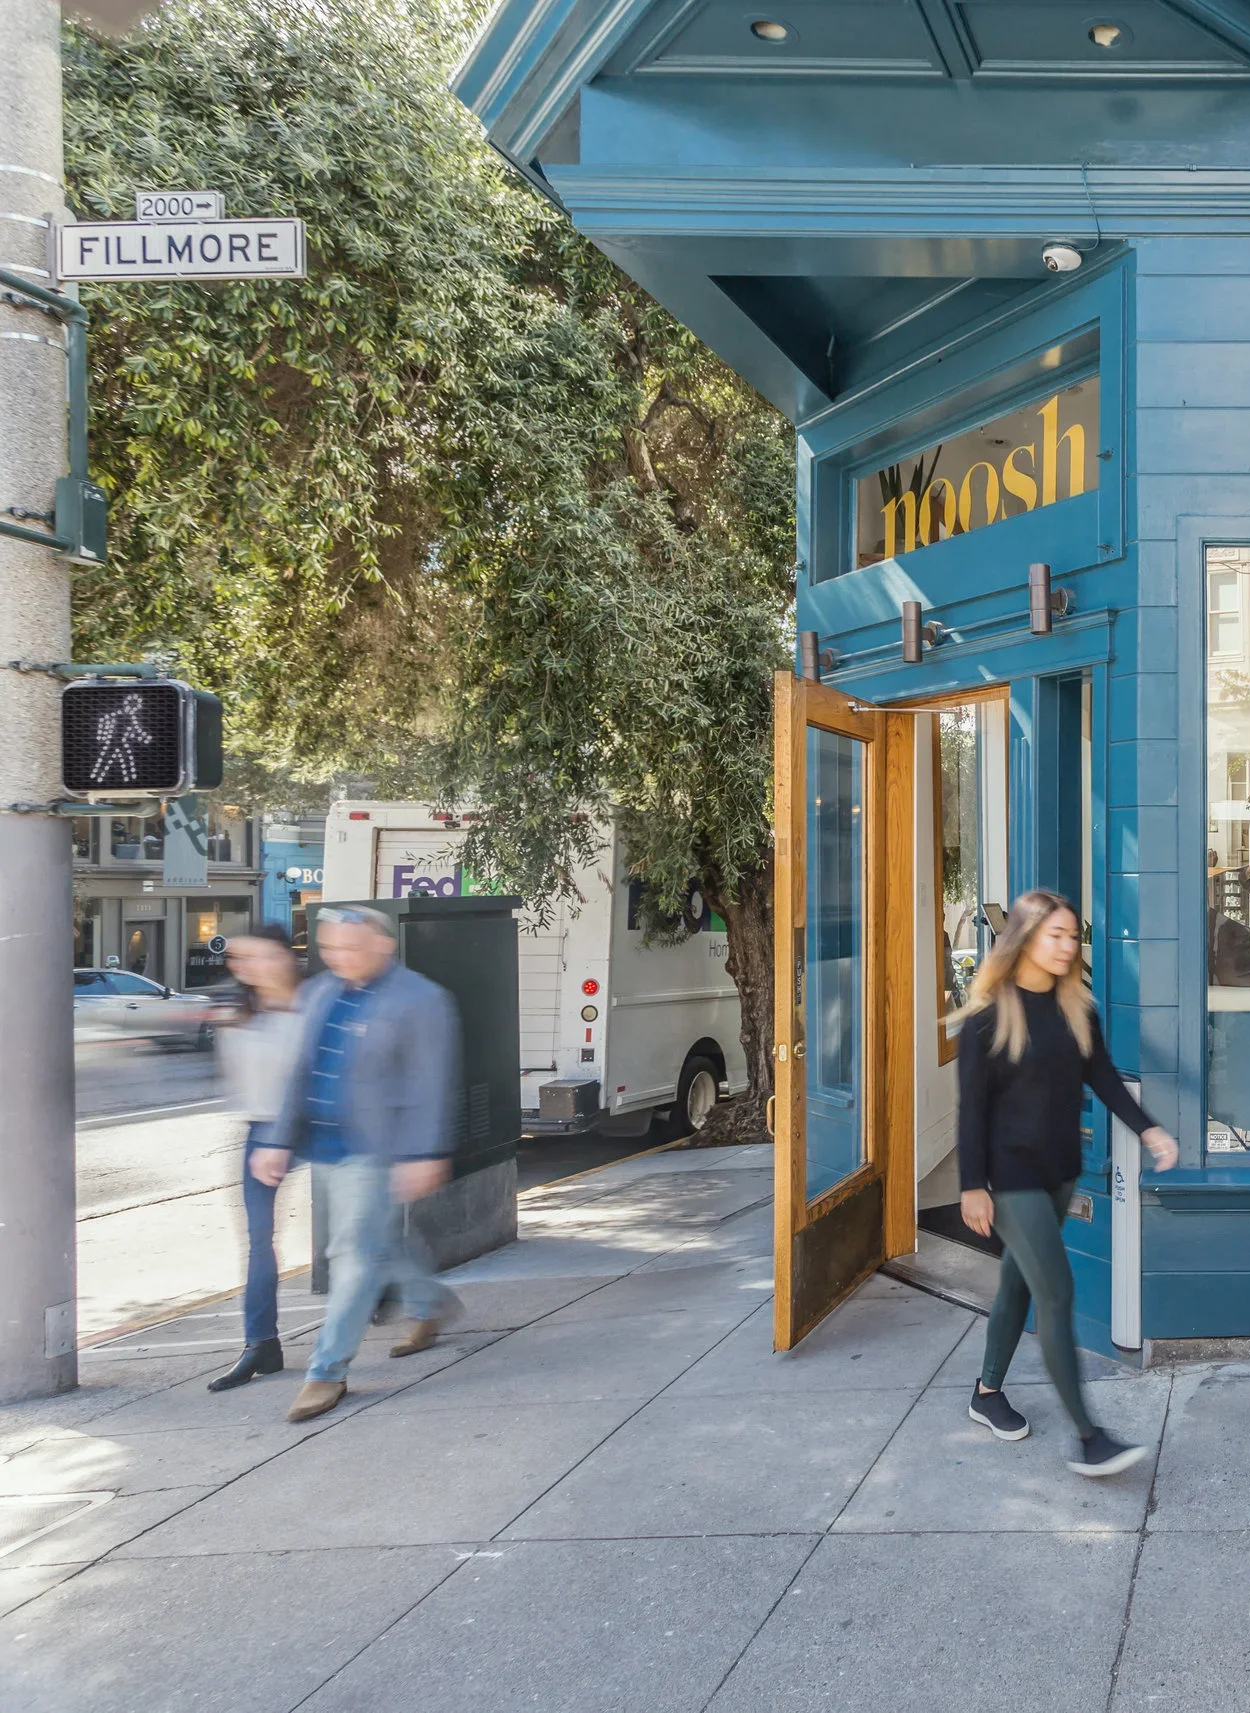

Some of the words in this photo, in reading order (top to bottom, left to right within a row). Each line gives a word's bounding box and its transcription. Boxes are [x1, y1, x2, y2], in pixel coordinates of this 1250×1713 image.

[142, 197, 193, 216] 2000
[80, 233, 278, 265] FILLMORE
[880, 395, 1085, 560] noosh
[215, 938, 222, 949] 5
